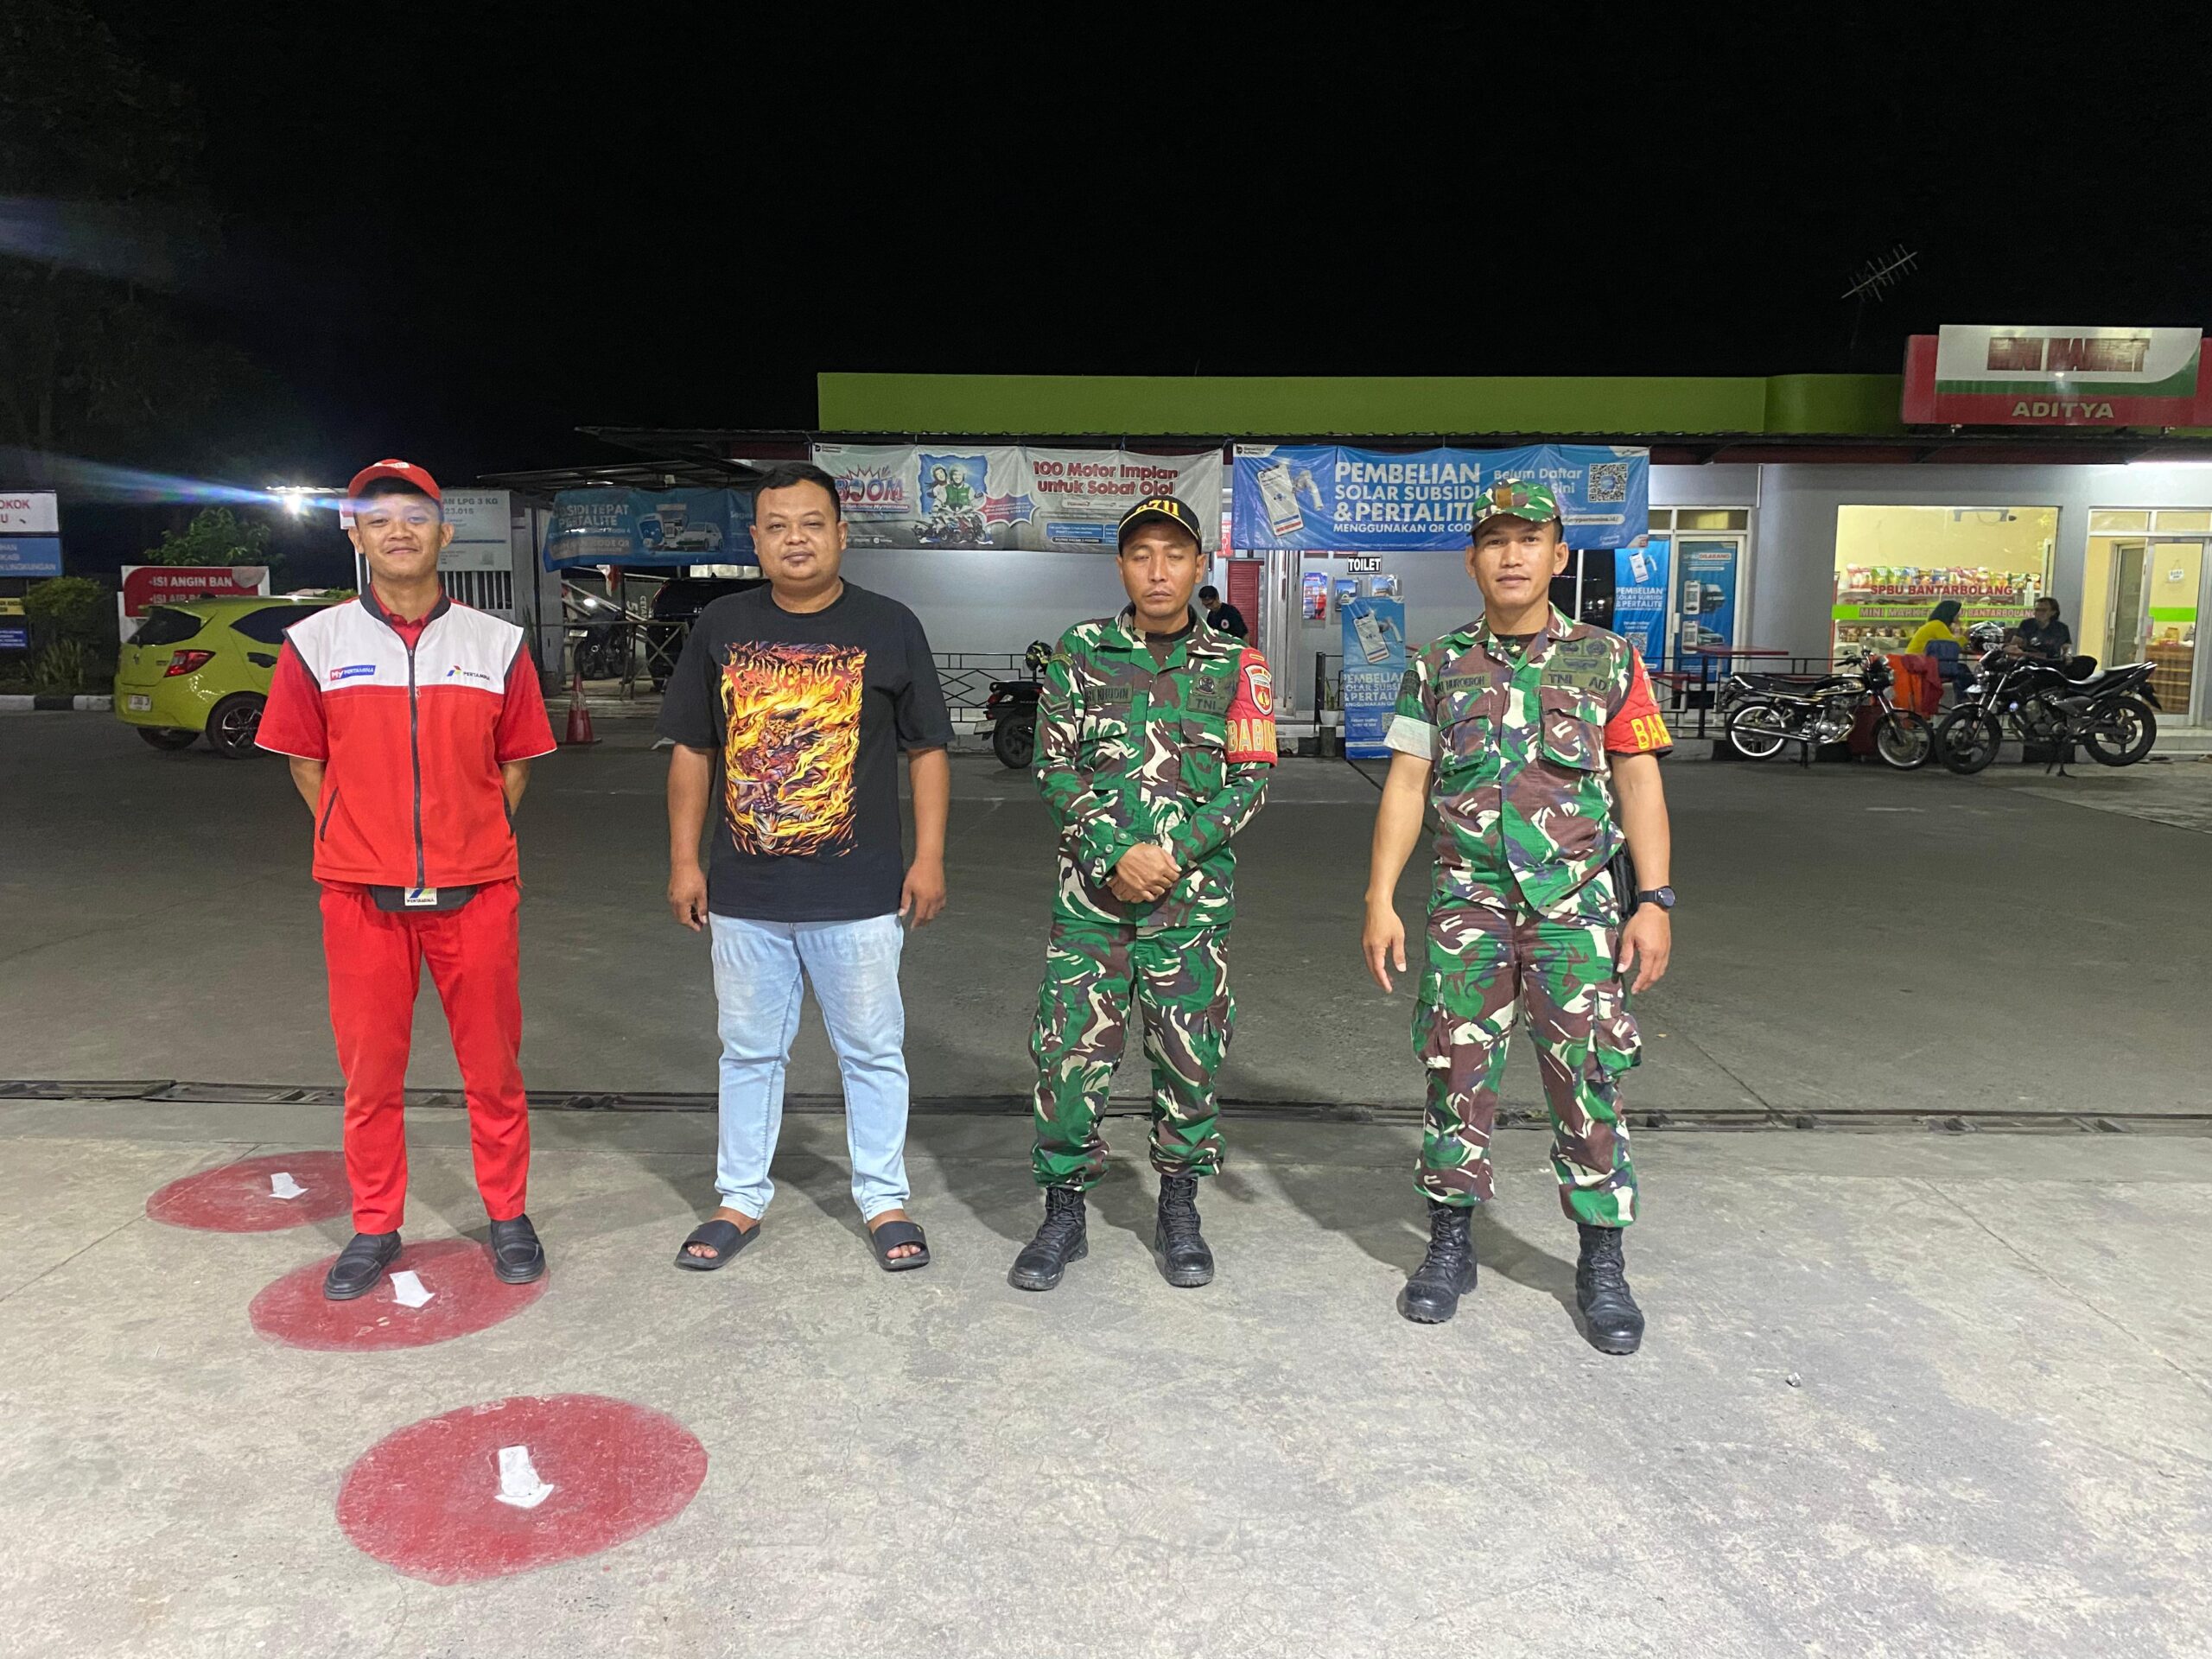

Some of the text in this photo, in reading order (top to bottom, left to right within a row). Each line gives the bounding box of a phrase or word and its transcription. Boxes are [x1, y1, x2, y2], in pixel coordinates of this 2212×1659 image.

[2012, 402, 2114, 418] ADITYA
[1033, 461, 1179, 480] 100 Motor Impian
[1335, 462, 1480, 484] PEMBELIAN
[1494, 467, 1583, 480] Belum Daftar
[1038, 480, 1173, 496] untuk Sobat Ojol
[1335, 485, 1480, 500] SOLAR SUBSIDI
[1551, 482, 1575, 493] Sini
[591, 504, 629, 515] TEPAT
[1333, 502, 1352, 522] &
[1333, 524, 1472, 533] MENGGUNAKAN QR COD
[1348, 558, 1381, 571] TOILET
[153, 576, 232, 587] ISI ANGIN BAN
[1871, 584, 2013, 595] SPBU BANTARBOLANG
[1859, 607, 1930, 617] MINI MARKE
[463, 671, 490, 681] PERTAMINA
[1548, 673, 1607, 690] TNI AD
[1345, 683, 1371, 692] OLAR
[1196, 698, 1216, 710] TNI
